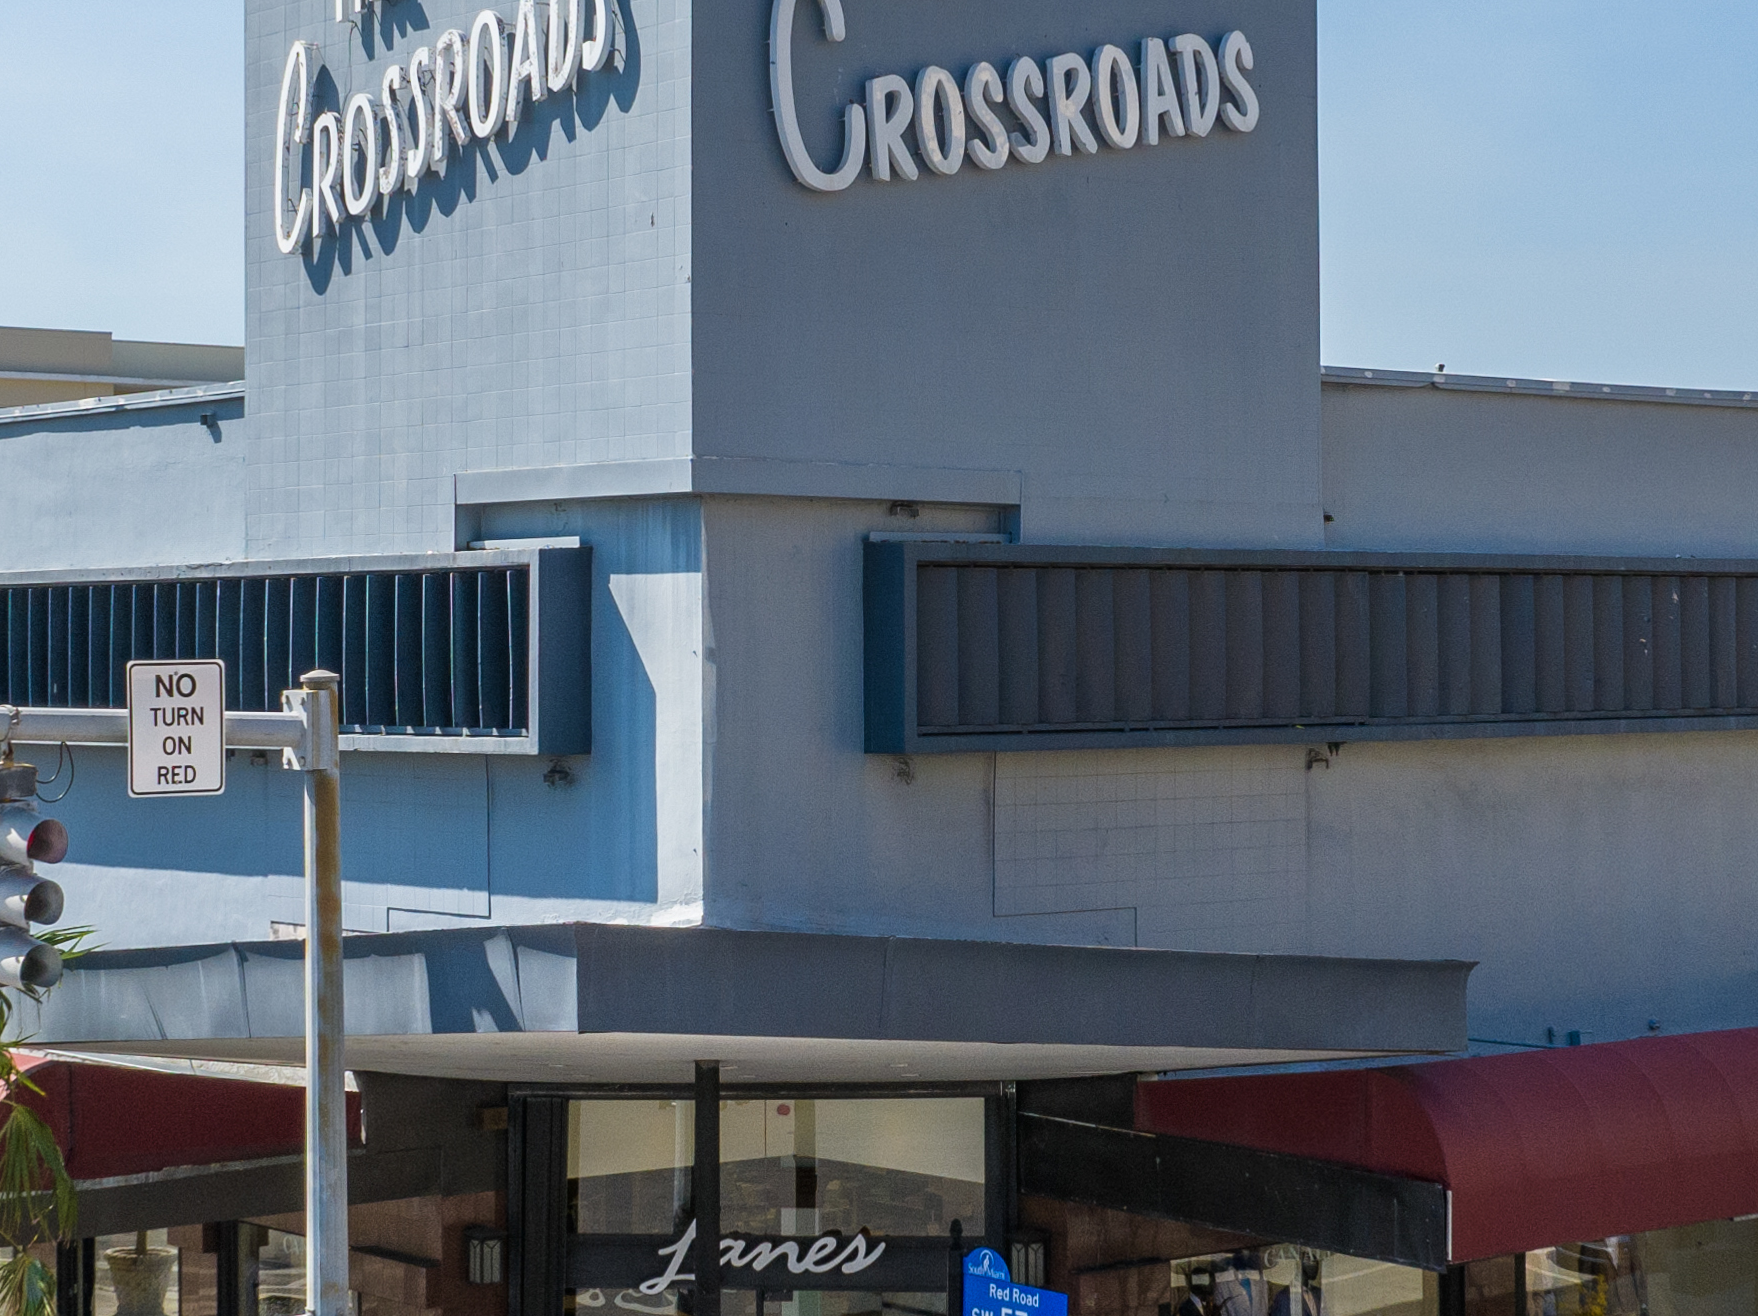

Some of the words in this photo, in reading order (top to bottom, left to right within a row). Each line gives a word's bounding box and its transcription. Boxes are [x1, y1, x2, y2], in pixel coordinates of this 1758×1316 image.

[155, 673, 197, 698] NO
[149, 706, 204, 727] TURN
[162, 735, 192, 755] ON
[157, 765, 197, 785] RED
[639, 1218, 886, 1295] Lanes
[989, 1283, 1010, 1301] Red
[1012, 1287, 1040, 1308] Road
